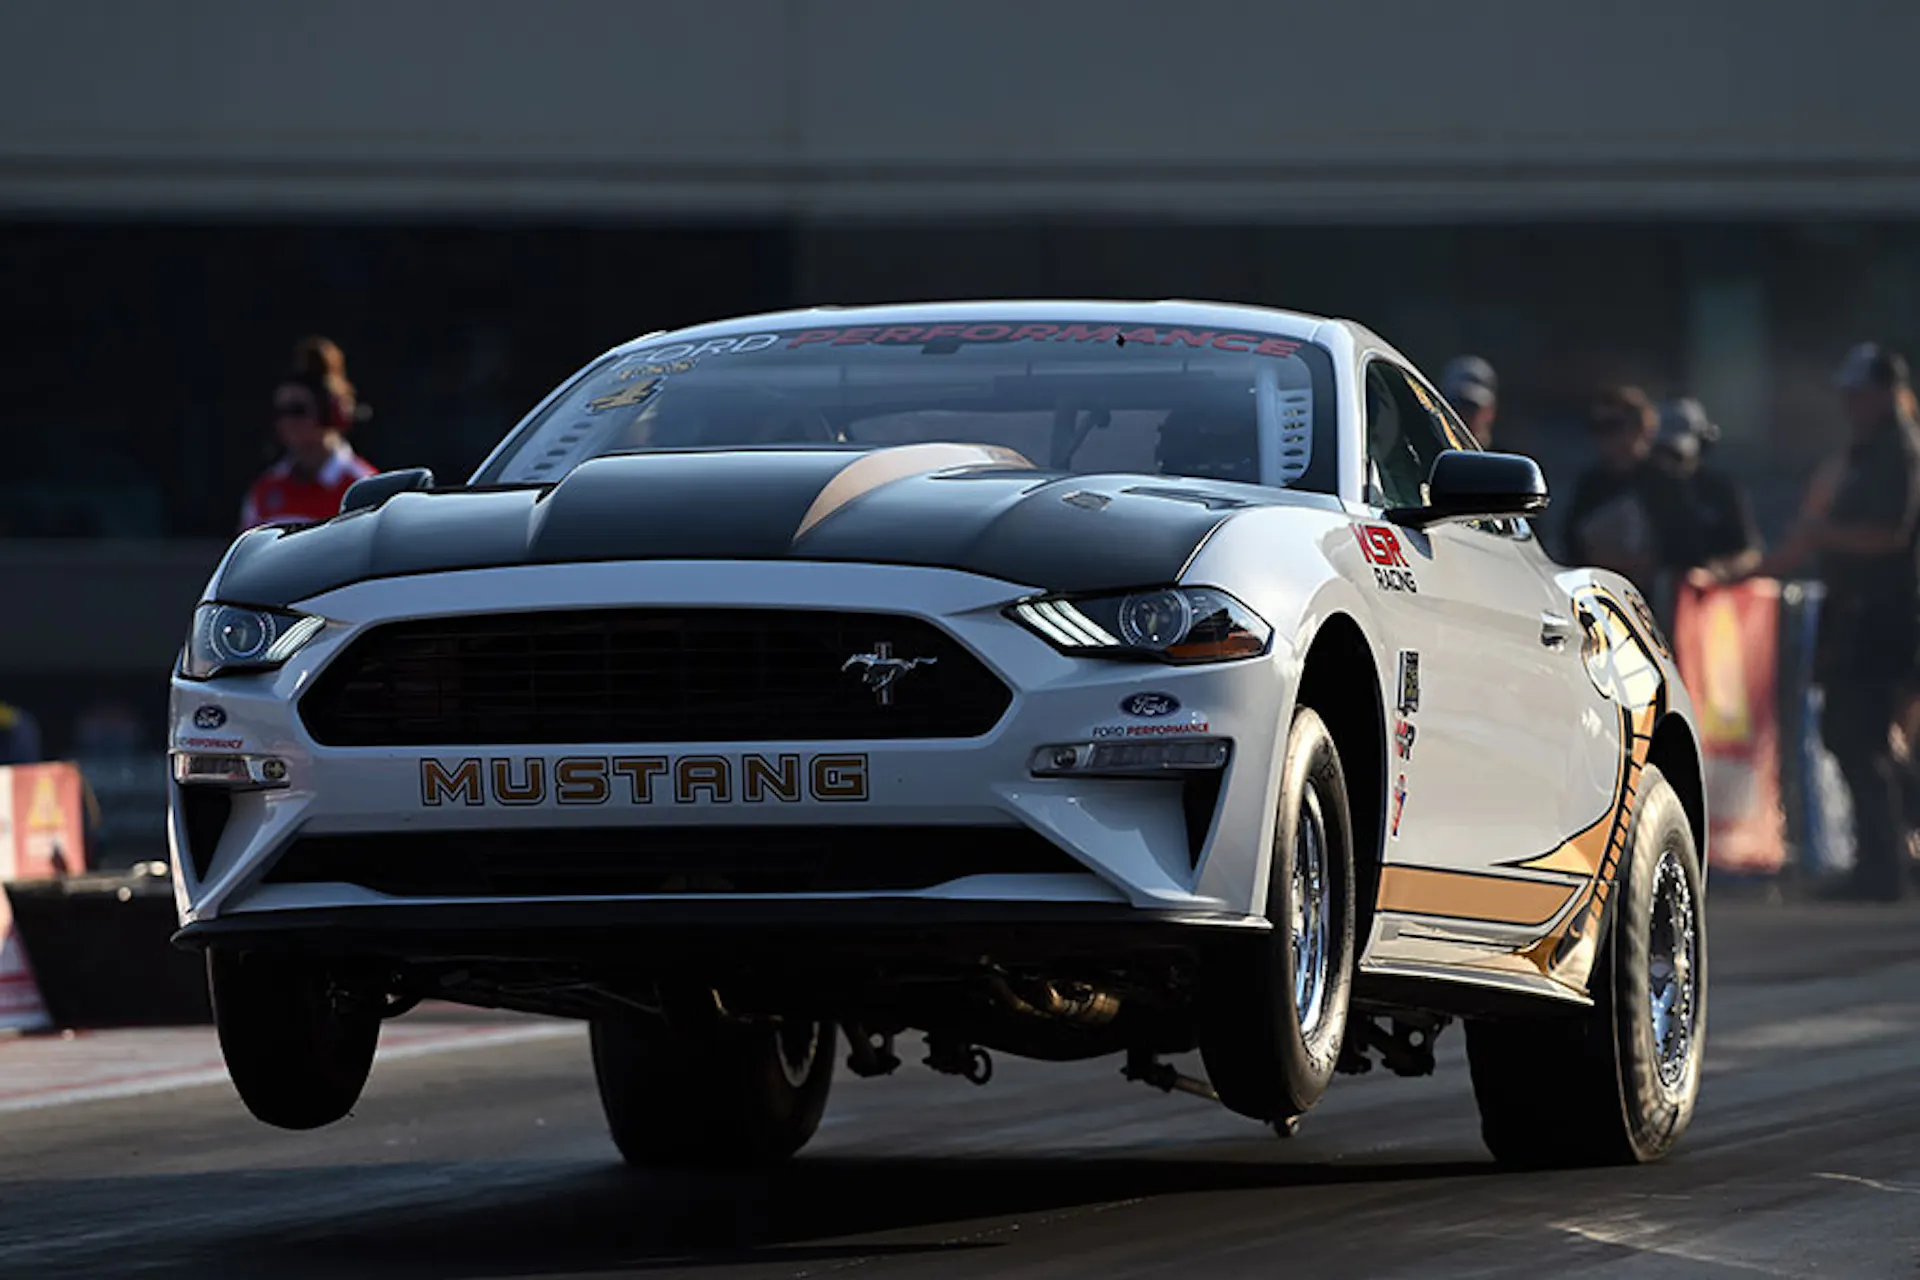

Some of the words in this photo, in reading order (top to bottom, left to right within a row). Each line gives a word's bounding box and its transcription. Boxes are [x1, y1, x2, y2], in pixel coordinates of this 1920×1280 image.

[610, 334, 780, 370] FORD
[787, 324, 1301, 358] PERFORMANCE
[1129, 694, 1171, 717] Ford
[1126, 723, 1209, 736] PERFORMANCE
[419, 754, 869, 806] MUSTANG
